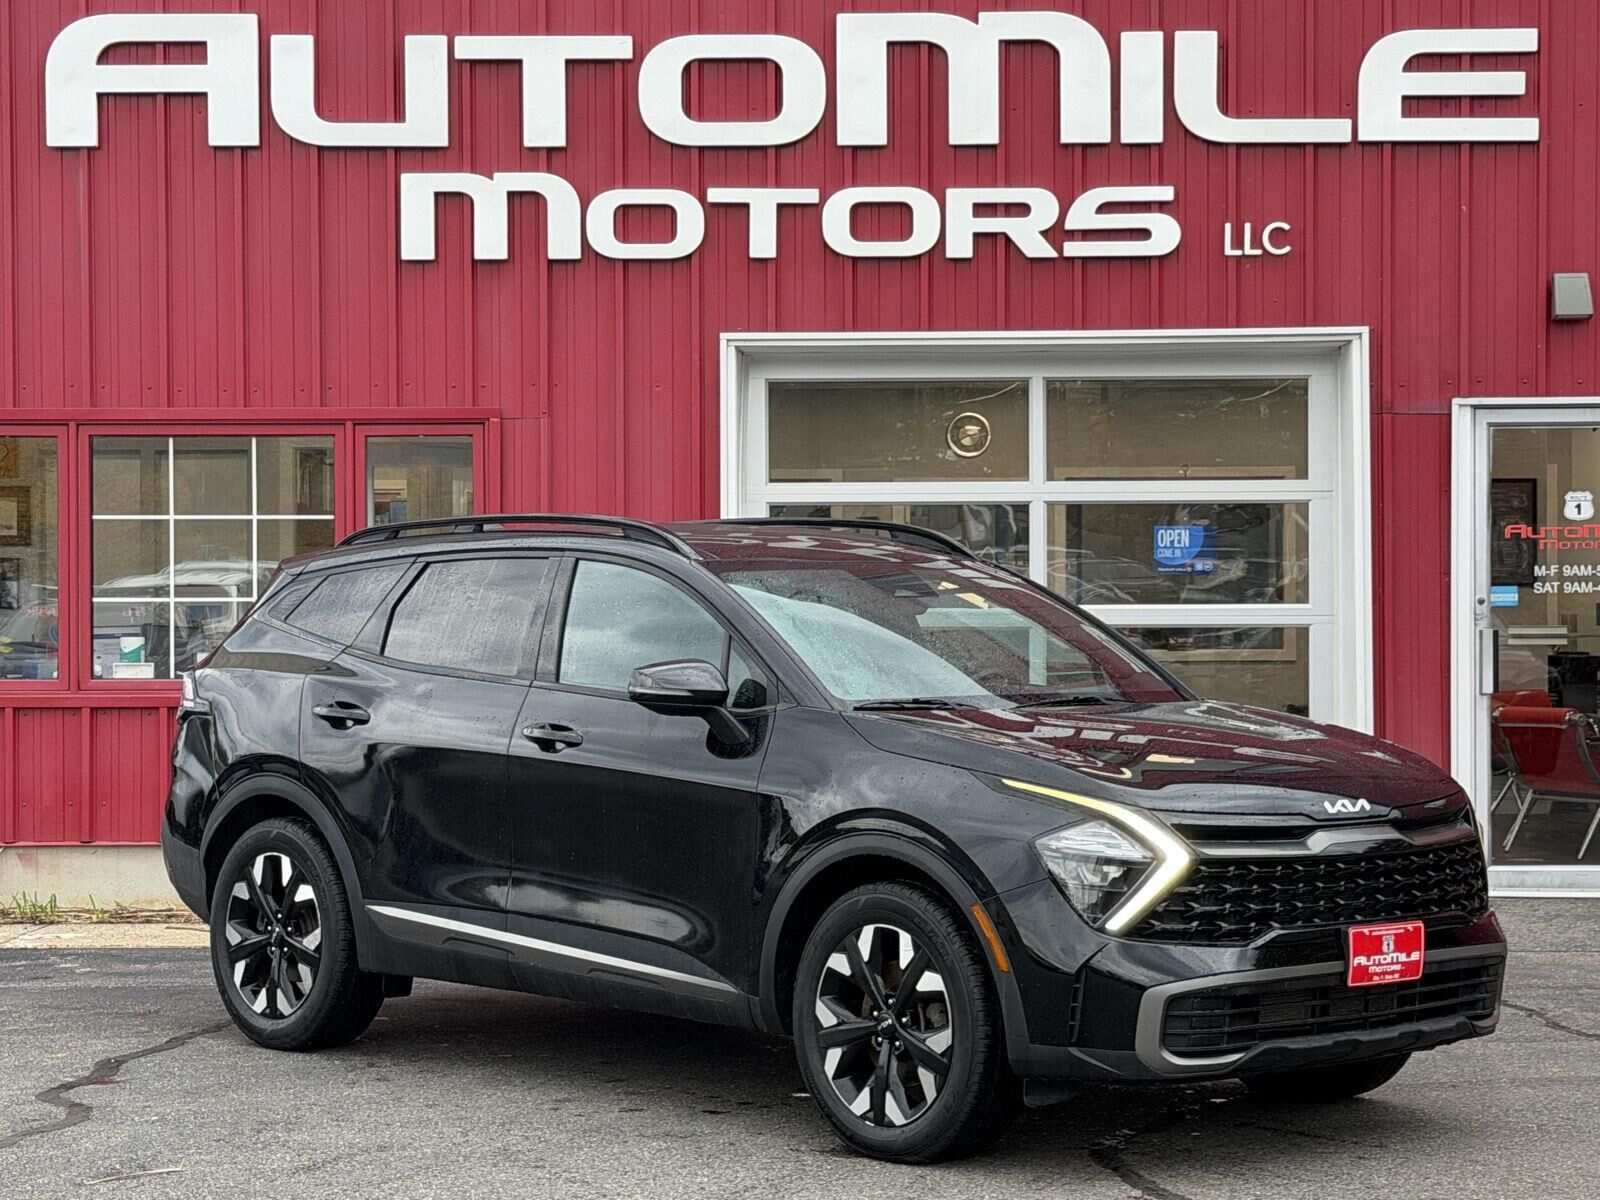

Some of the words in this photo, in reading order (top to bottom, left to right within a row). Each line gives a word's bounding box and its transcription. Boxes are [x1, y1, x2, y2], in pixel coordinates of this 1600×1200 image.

[45, 11, 1540, 148] AUTOMILE
[401, 171, 1182, 261] MOTORS
[1224, 222, 1292, 256] LLC
[1574, 502, 1581, 515] 1
[1157, 529, 1189, 547] OPEN
[1533, 564, 1560, 577] M-F
[1533, 581, 1561, 594] SAT
[1323, 798, 1372, 814] KIA
[1353, 951, 1420, 967] AUTOMILE
